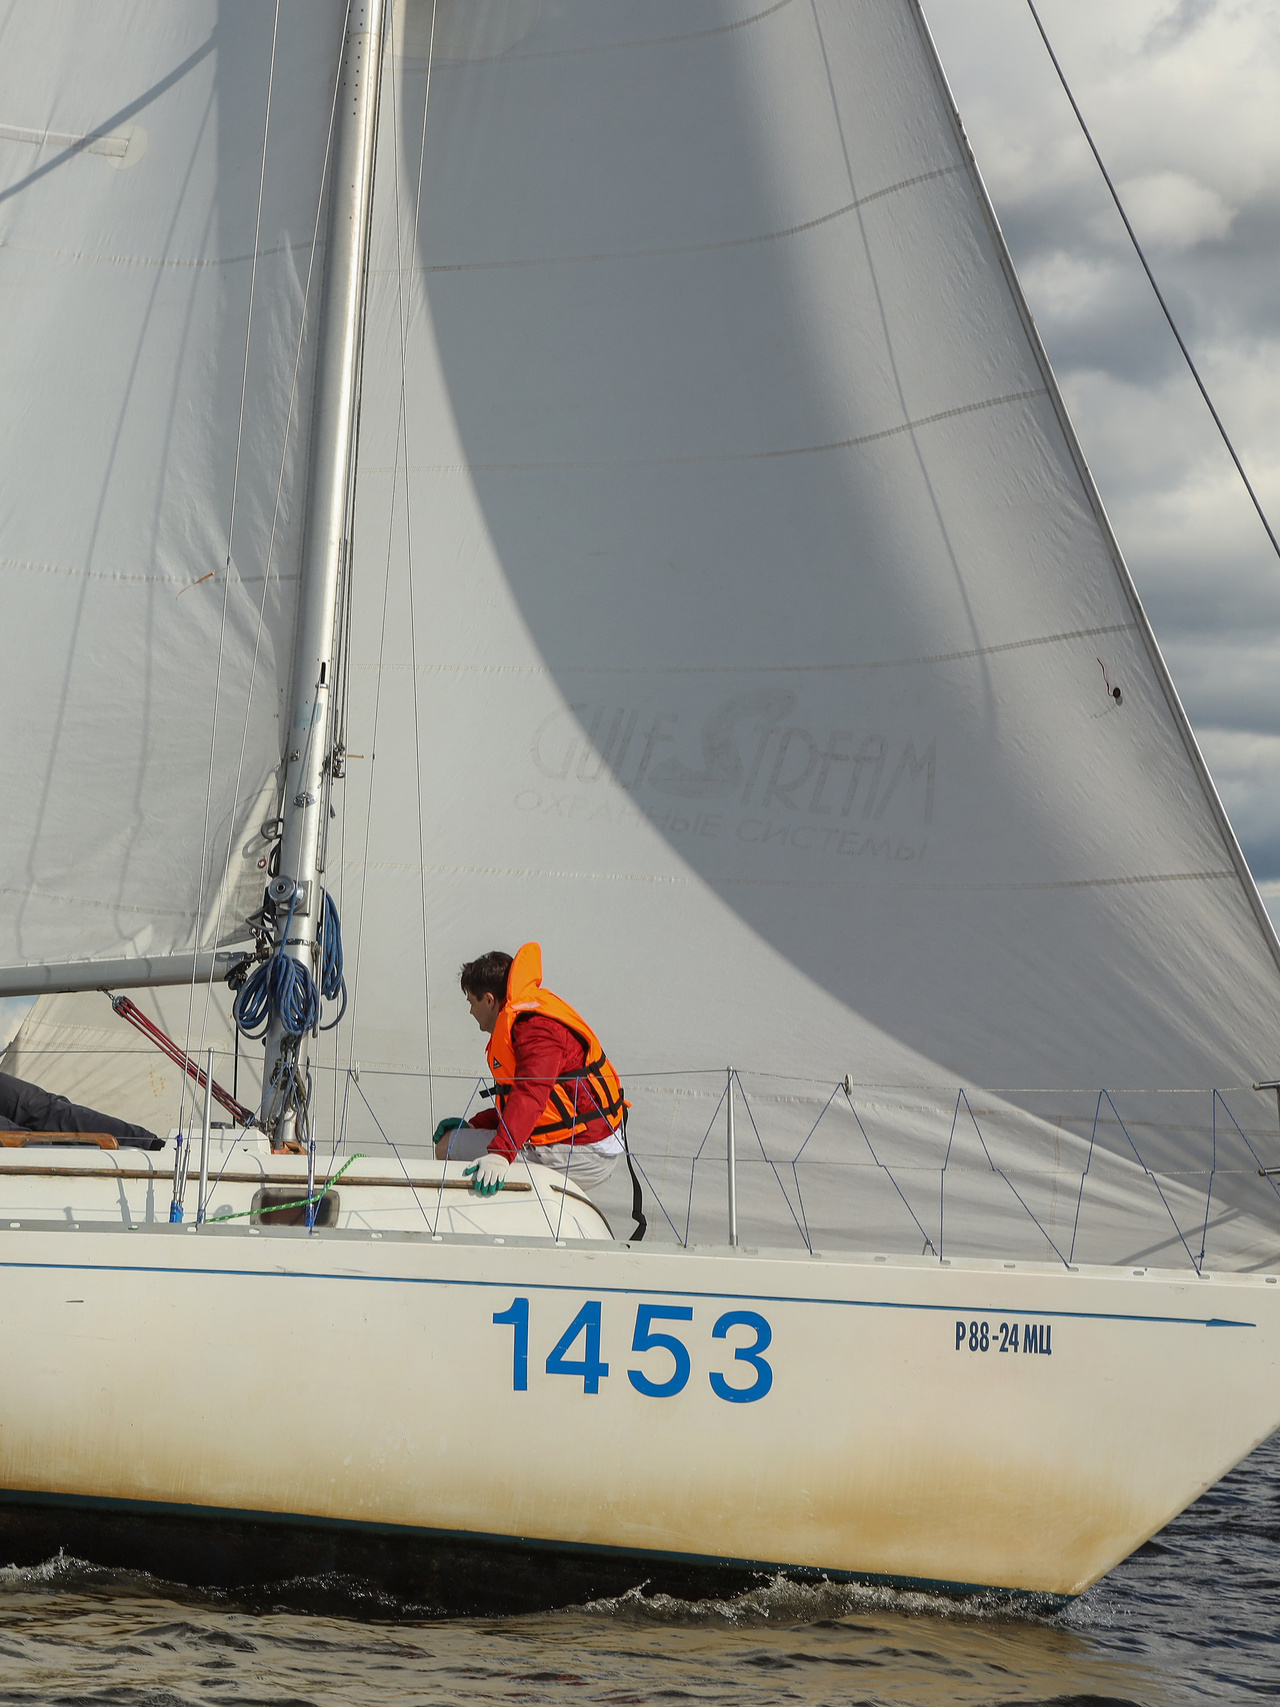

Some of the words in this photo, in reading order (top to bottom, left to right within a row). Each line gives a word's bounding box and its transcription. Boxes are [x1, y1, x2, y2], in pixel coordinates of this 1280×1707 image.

[530, 701, 678, 792] GULF
[734, 816, 929, 863] СИСТЕМЫ
[492, 1297, 773, 1403] 1453
